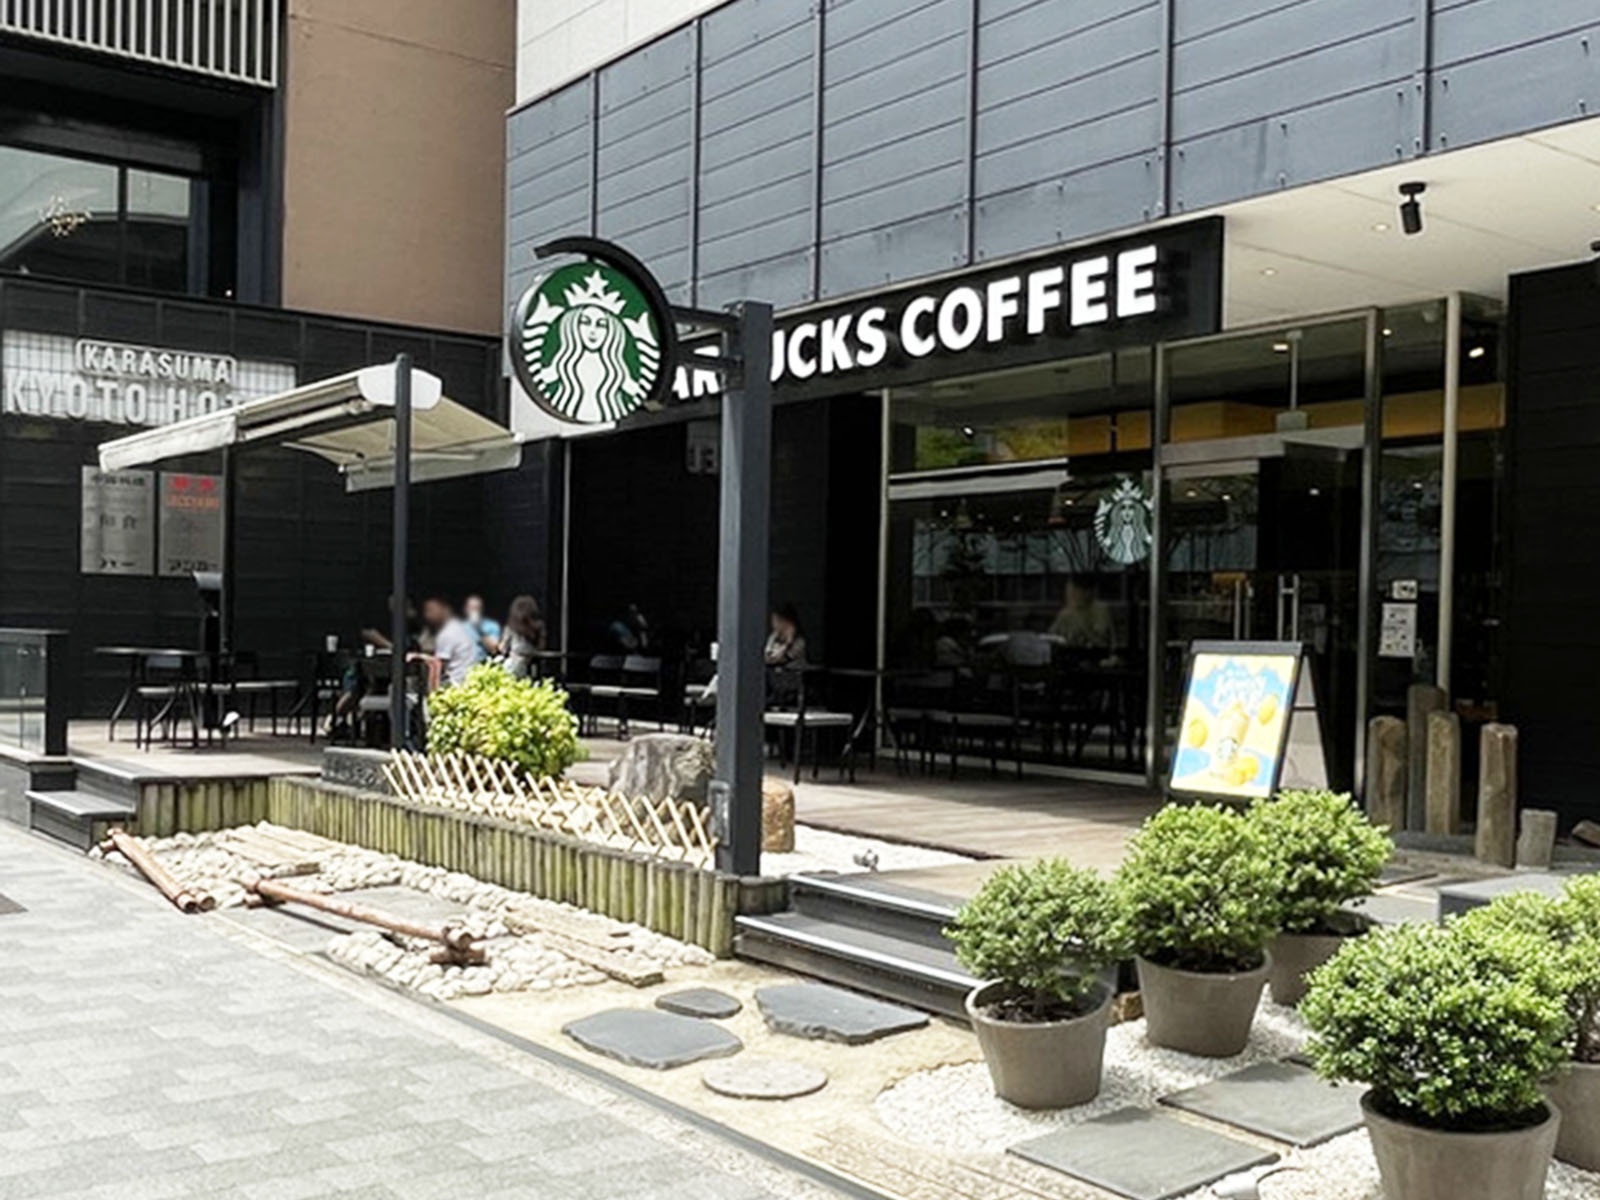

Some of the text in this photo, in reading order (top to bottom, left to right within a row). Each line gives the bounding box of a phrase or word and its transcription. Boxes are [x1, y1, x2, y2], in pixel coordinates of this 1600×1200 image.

[900, 245, 1157, 357] COFFEE
[84, 344, 230, 384] KARASUMA
[6, 368, 147, 424] KYOTO
